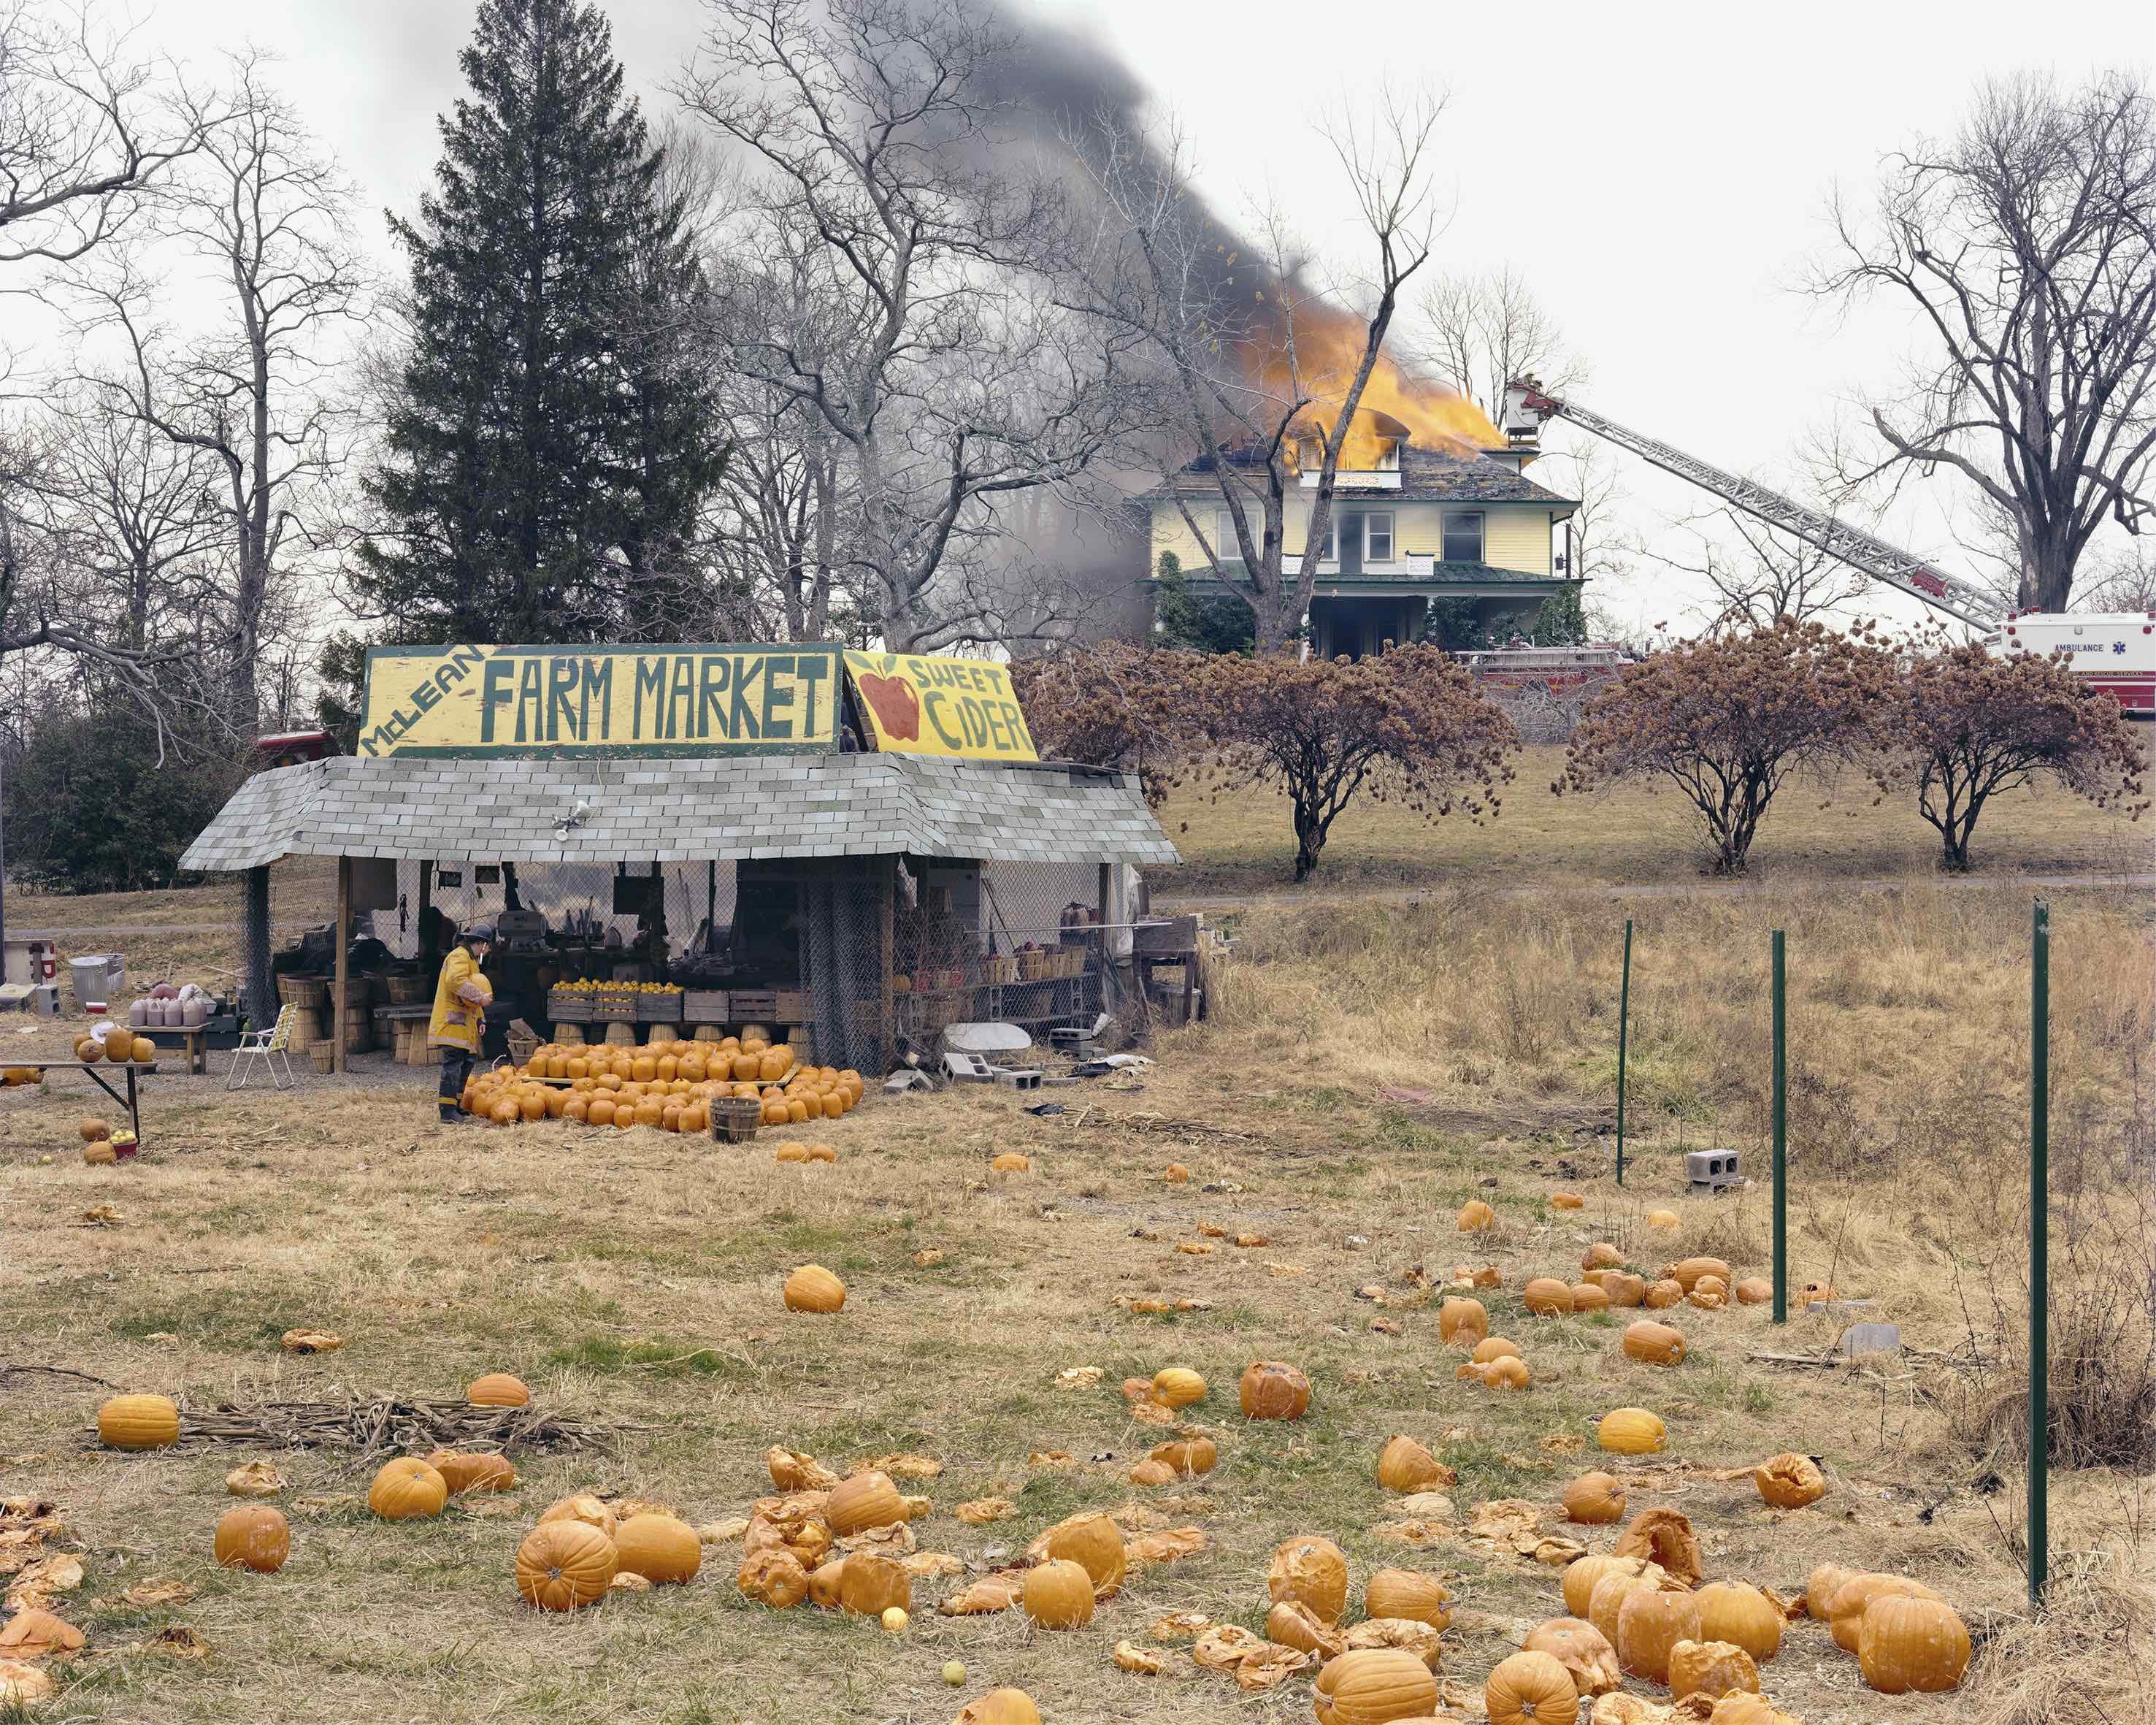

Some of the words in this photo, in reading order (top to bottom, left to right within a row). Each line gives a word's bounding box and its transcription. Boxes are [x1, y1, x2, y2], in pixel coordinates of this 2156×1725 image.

[2055, 644, 2103, 652] AMBULANCE
[481, 657, 613, 743] FARM
[632, 657, 829, 740] MARKET
[907, 659, 1002, 695] SWEET
[923, 691, 1035, 752] CIDER
